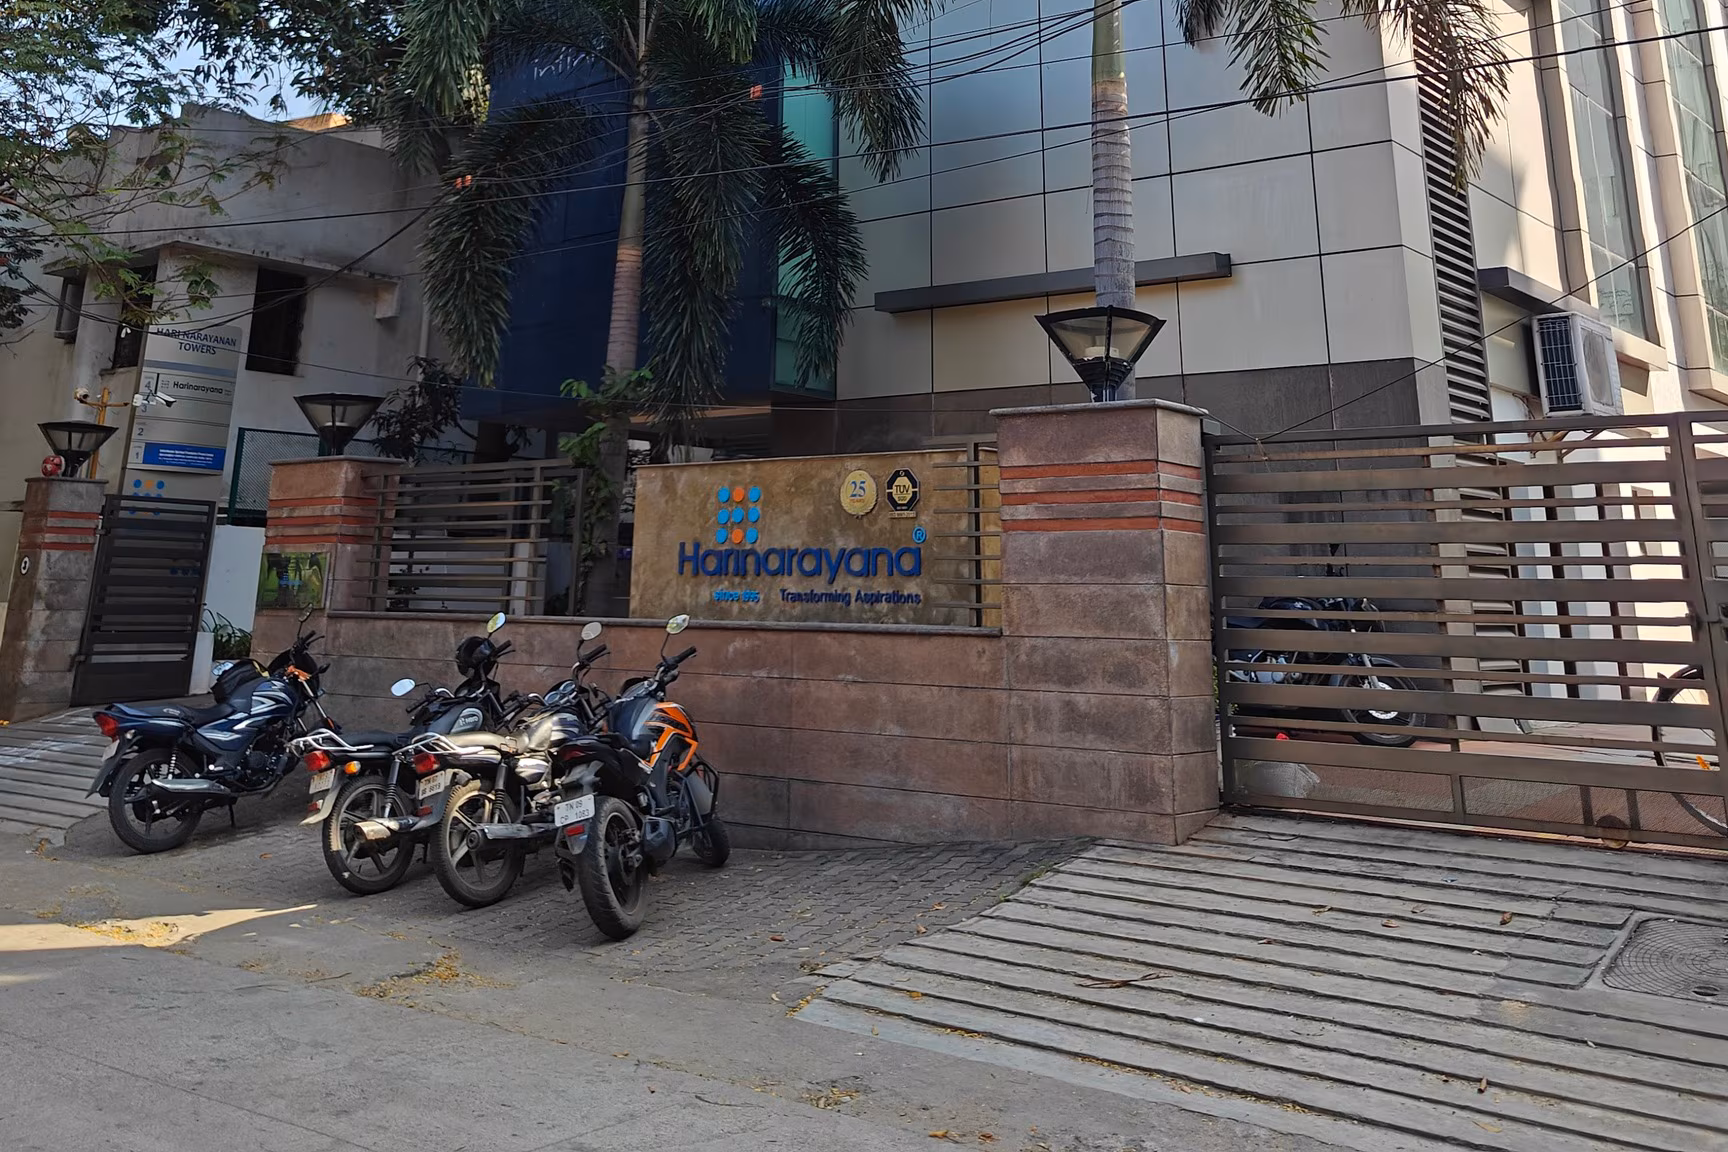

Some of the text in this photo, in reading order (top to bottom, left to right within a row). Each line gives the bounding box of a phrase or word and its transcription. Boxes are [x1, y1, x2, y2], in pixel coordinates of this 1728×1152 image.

[183, 332, 237, 347] NARAYANAN
[179, 342, 216, 355] TOWERS
[173, 381, 223, 394] Harinarayana
[137, 428, 144, 436] 2
[850, 480, 866, 498] 25
[678, 541, 922, 585] Harinarayana
[779, 588, 922, 606] Transforming Aspirations
